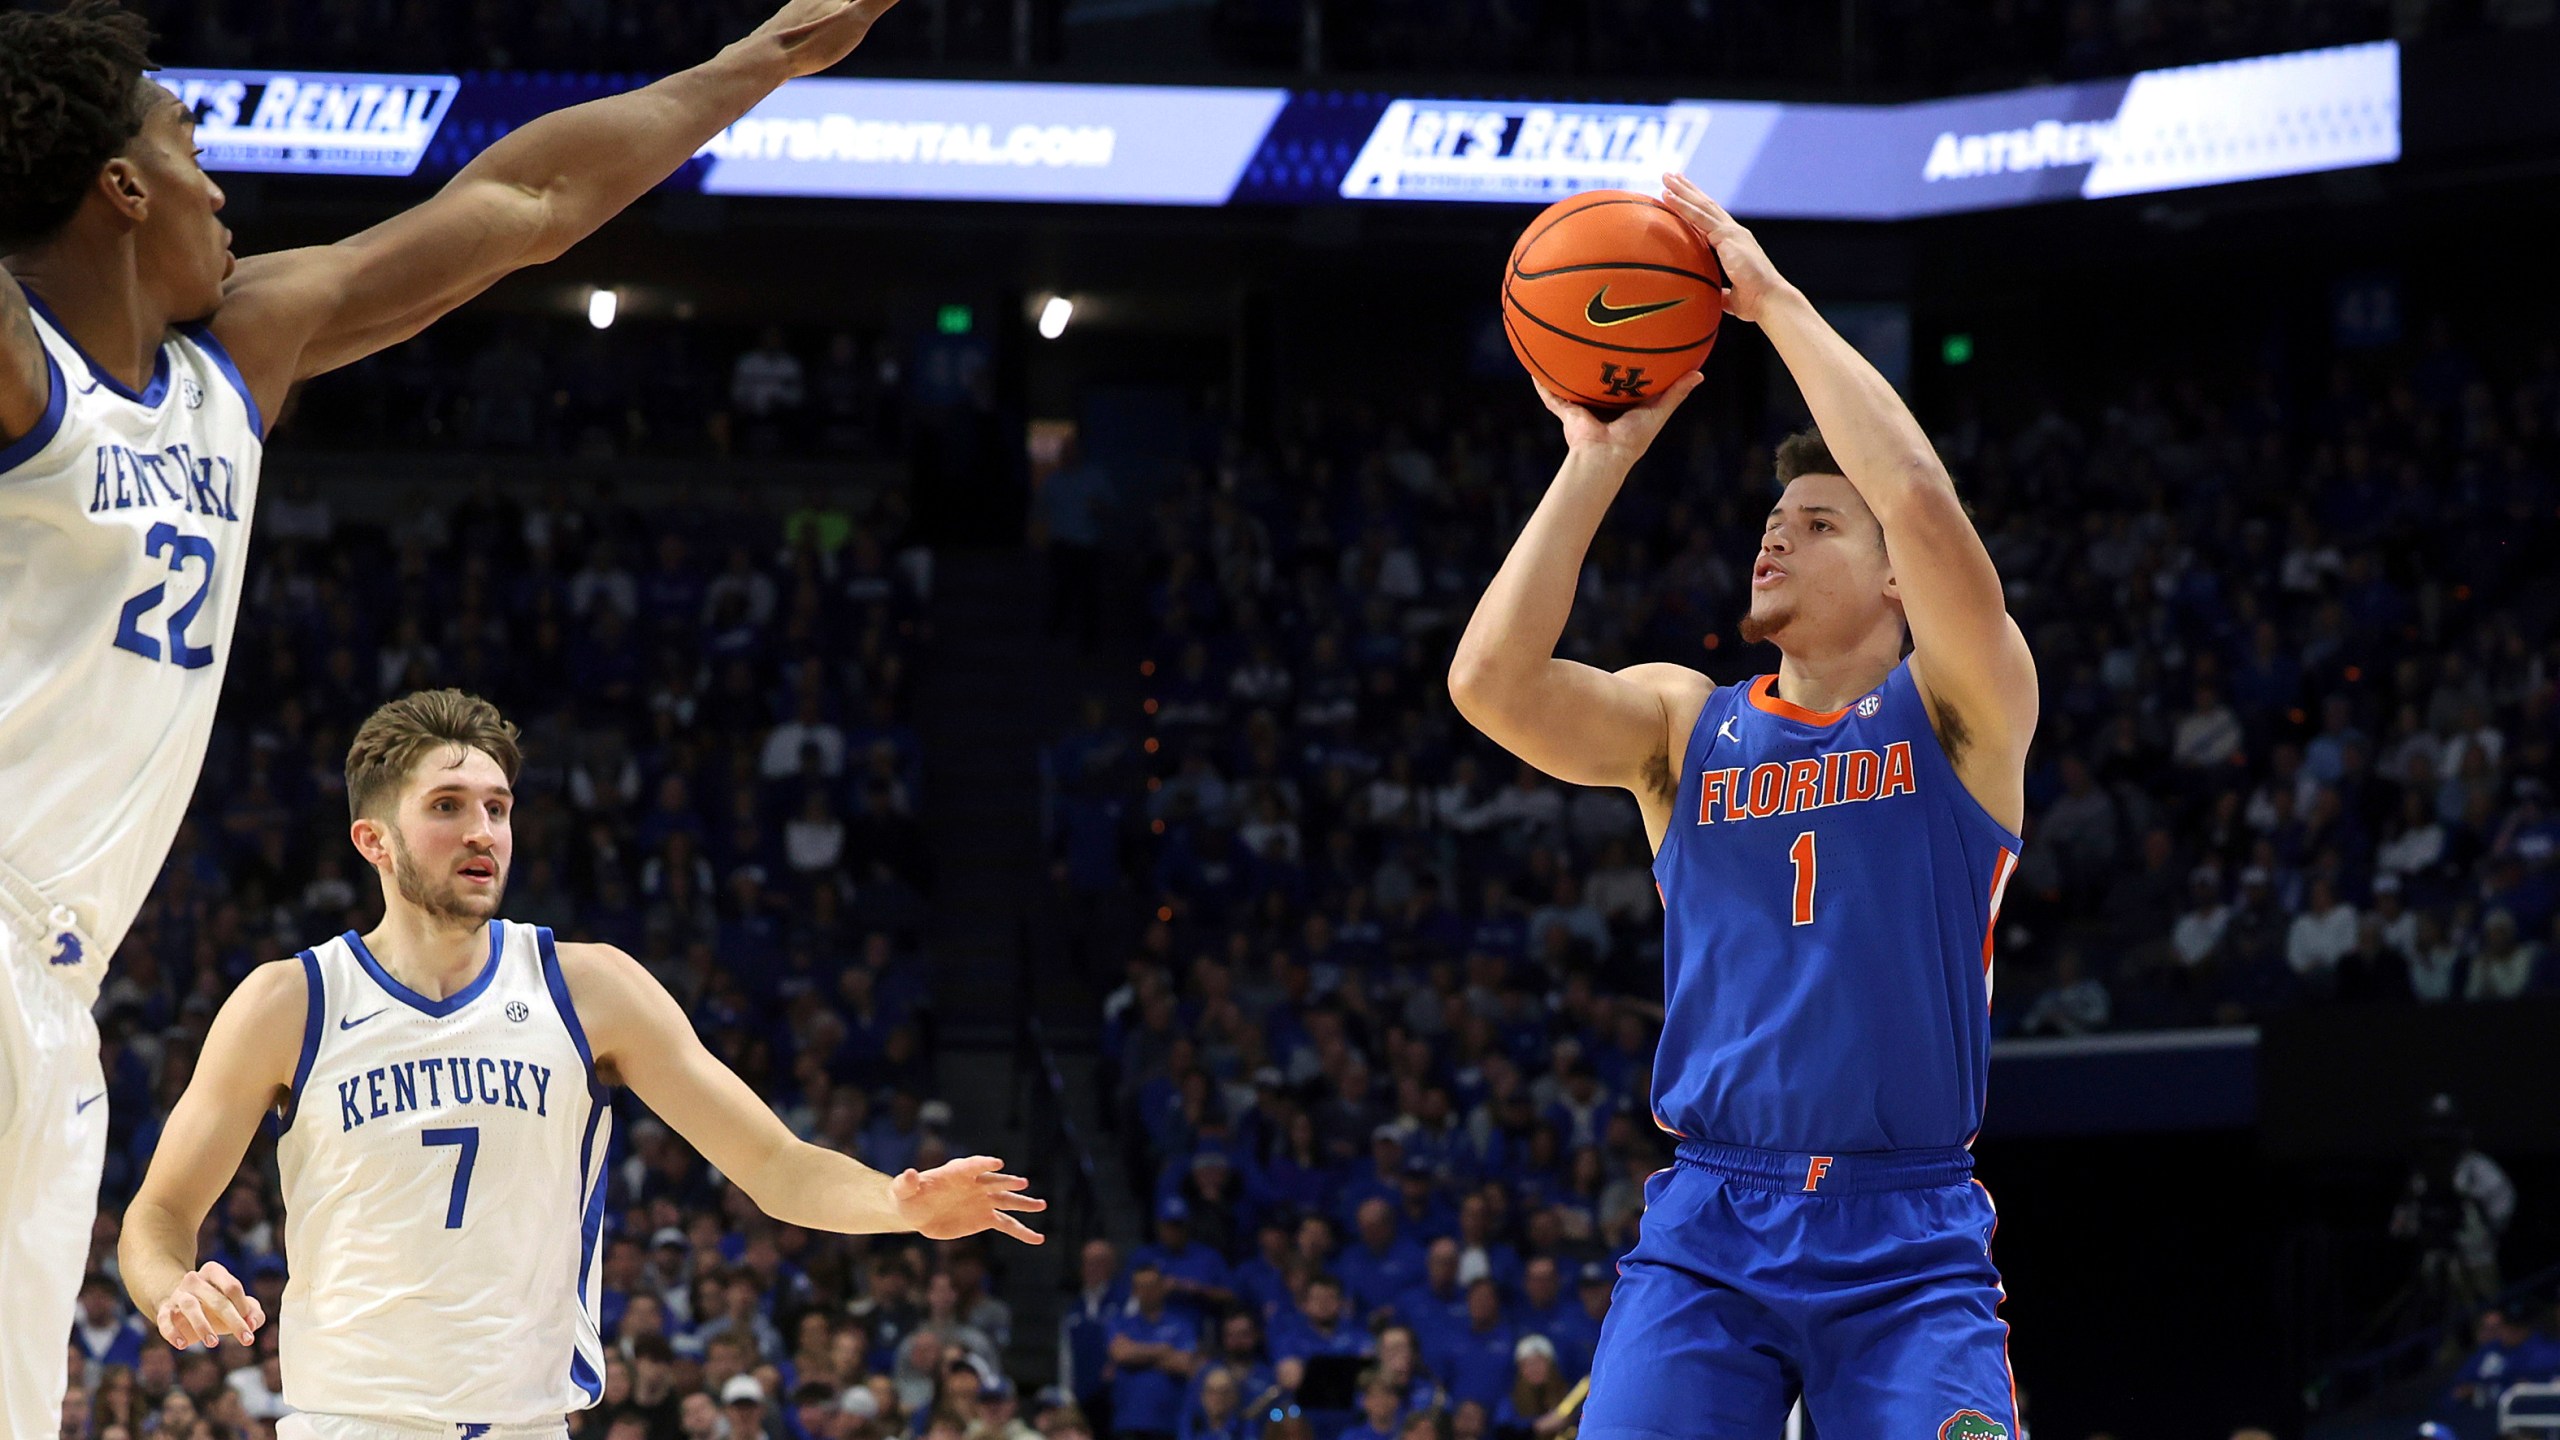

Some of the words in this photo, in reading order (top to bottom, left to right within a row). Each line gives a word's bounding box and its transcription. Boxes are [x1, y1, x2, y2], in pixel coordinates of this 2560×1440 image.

[252, 76, 434, 131] RENTAL
[1511, 107, 1694, 164] RENTAL
[1600, 361, 1652, 398] UK
[113, 521, 216, 669] 22
[1857, 695, 1881, 717] SEC
[1697, 741, 1916, 825] FLORIDA
[1789, 831, 1816, 926] 1
[506, 1001, 529, 1022] SEC
[338, 1057, 550, 1133] KENTUCKY
[421, 1126, 479, 1229] 7
[1802, 1156, 1833, 1191] F
